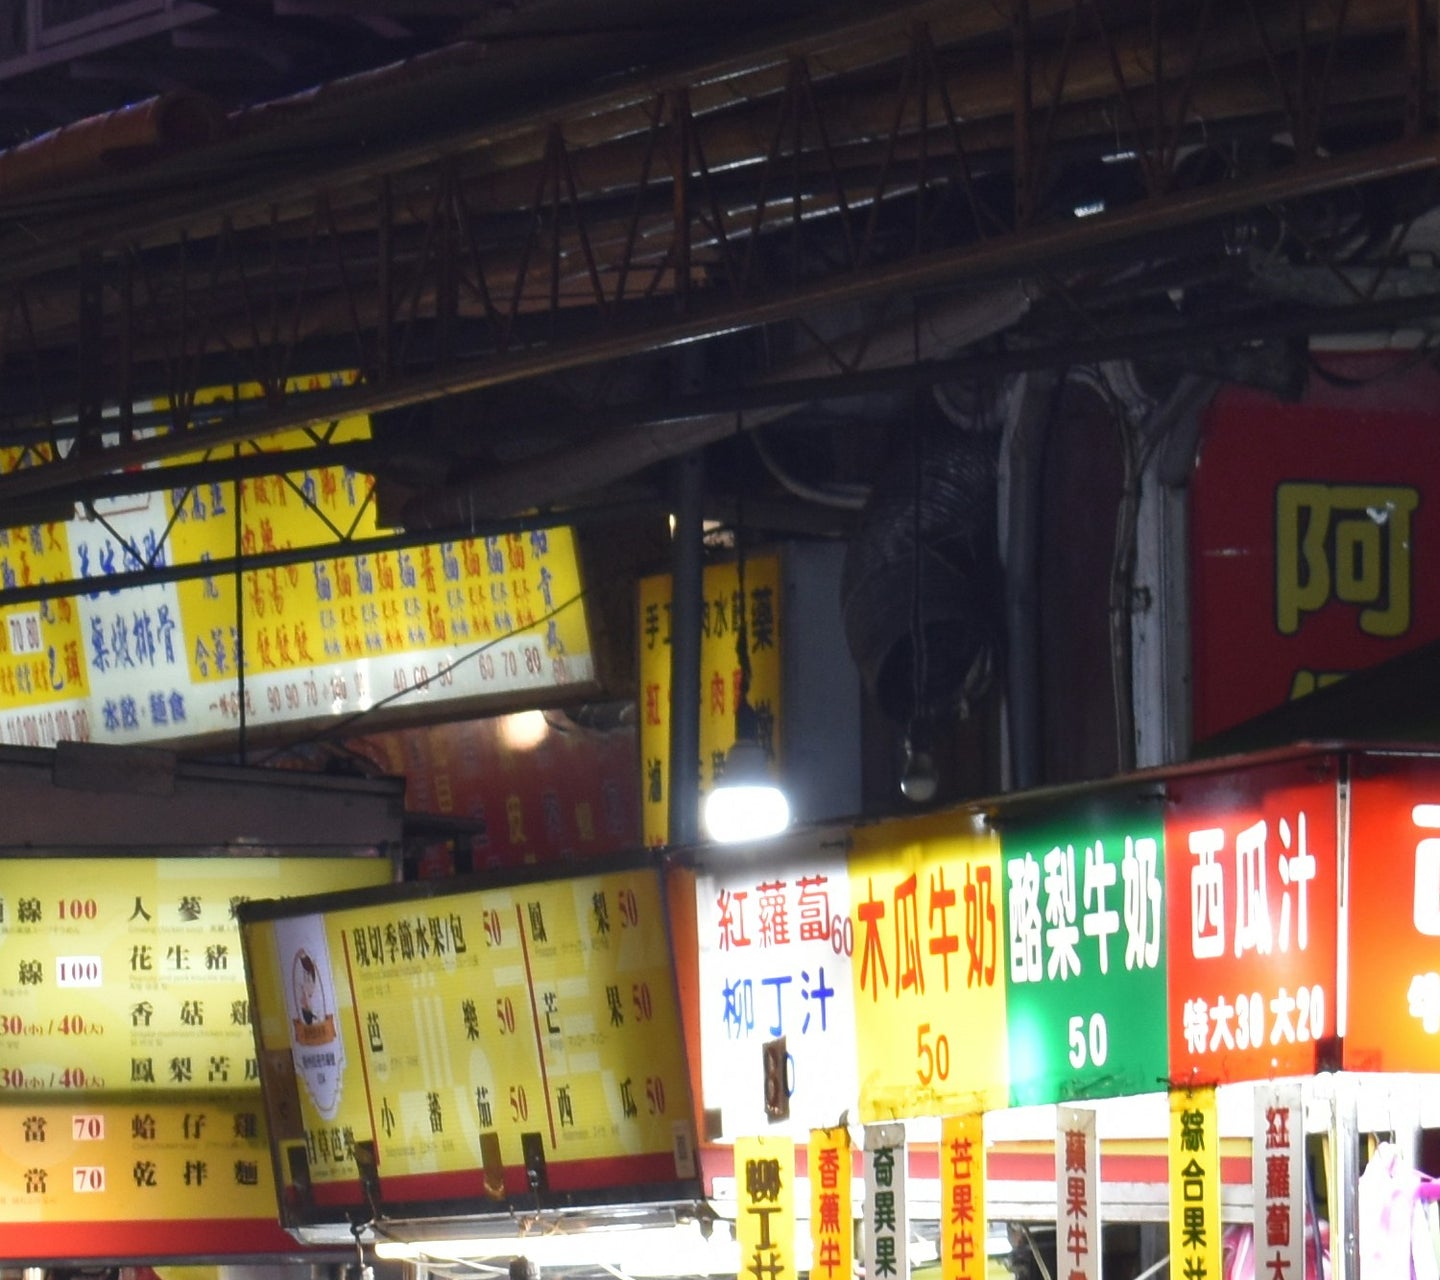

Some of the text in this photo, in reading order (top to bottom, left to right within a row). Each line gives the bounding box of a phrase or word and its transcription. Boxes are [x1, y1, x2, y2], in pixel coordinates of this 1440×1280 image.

[1274, 483, 1420, 704] 阿
[57, 898, 98, 922] 100
[618, 887, 639, 929] 50
[1008, 834, 1162, 984] 酪梨牛奶
[1188, 810, 1317, 961] 西瓜汁
[482, 907, 502, 948] 50
[716, 872, 855, 958] 紅蘿蔔 60
[856, 861, 997, 1004] 木瓜牛奶
[58, 962, 98, 982] 100
[497, 996, 516, 1036] 50
[542, 983, 653, 1035] 芒果 50
[721, 966, 834, 1039] 柳丁汁
[1270, 984, 1325, 1046] 大20
[917, 1023, 950, 1085] 50
[1068, 1013, 1108, 1068] 50
[510, 1085, 529, 1124] 50
[556, 1076, 666, 1128] 西瓜 50
[74, 1118, 101, 1139] 70
[75, 1169, 102, 1191] 70
